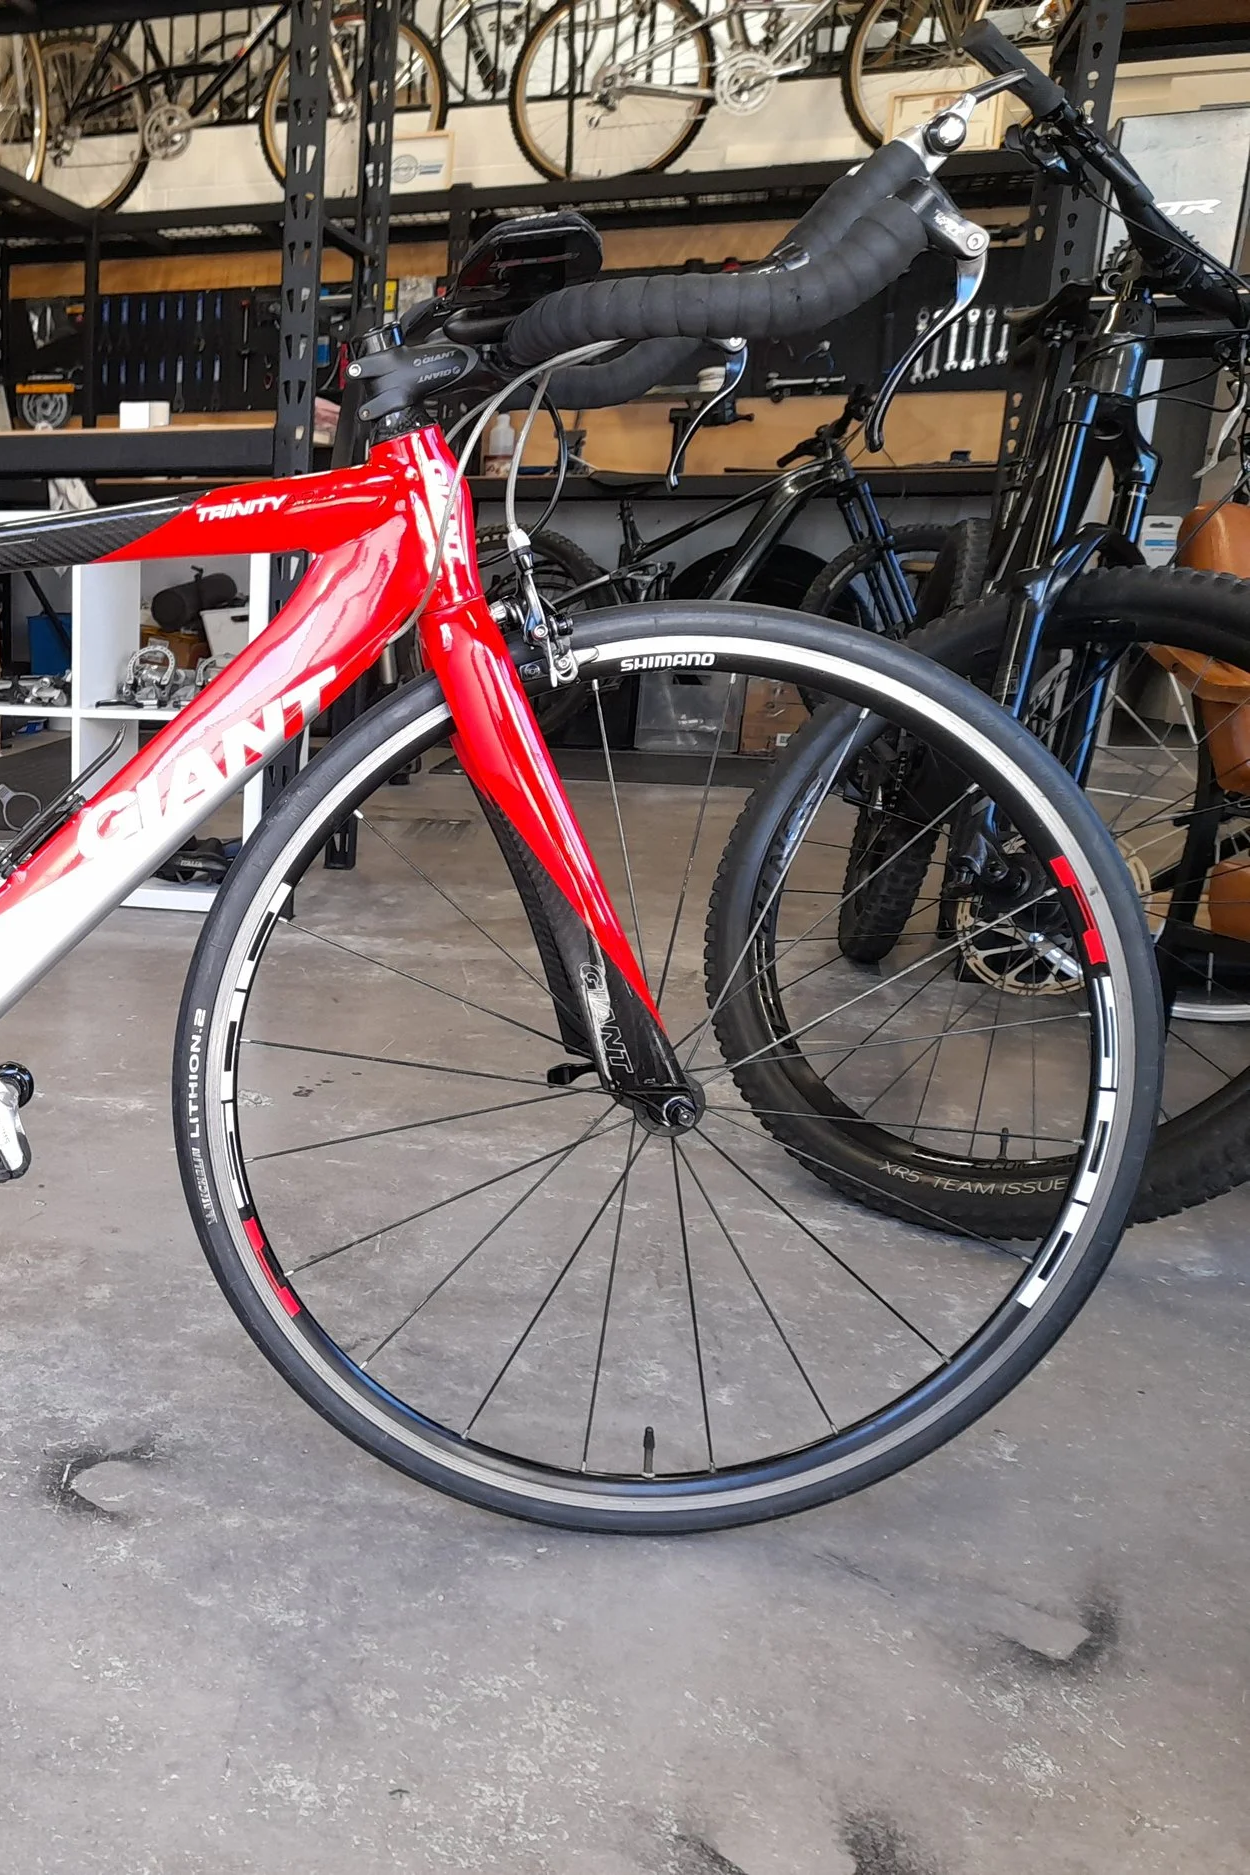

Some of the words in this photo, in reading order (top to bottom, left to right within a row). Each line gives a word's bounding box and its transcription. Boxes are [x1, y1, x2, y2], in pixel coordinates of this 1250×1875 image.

[1155, 198, 1222, 216] TR
[195, 494, 288, 523] TRINITY
[620, 653, 716, 672] SHIMANO
[77, 664, 338, 860] GIANT
[578, 962, 635, 1074] GIANT
[879, 1160, 923, 1184] XR5
[932, 1175, 996, 1196] TEAM
[1001, 1176, 1069, 1196] ISSUE
